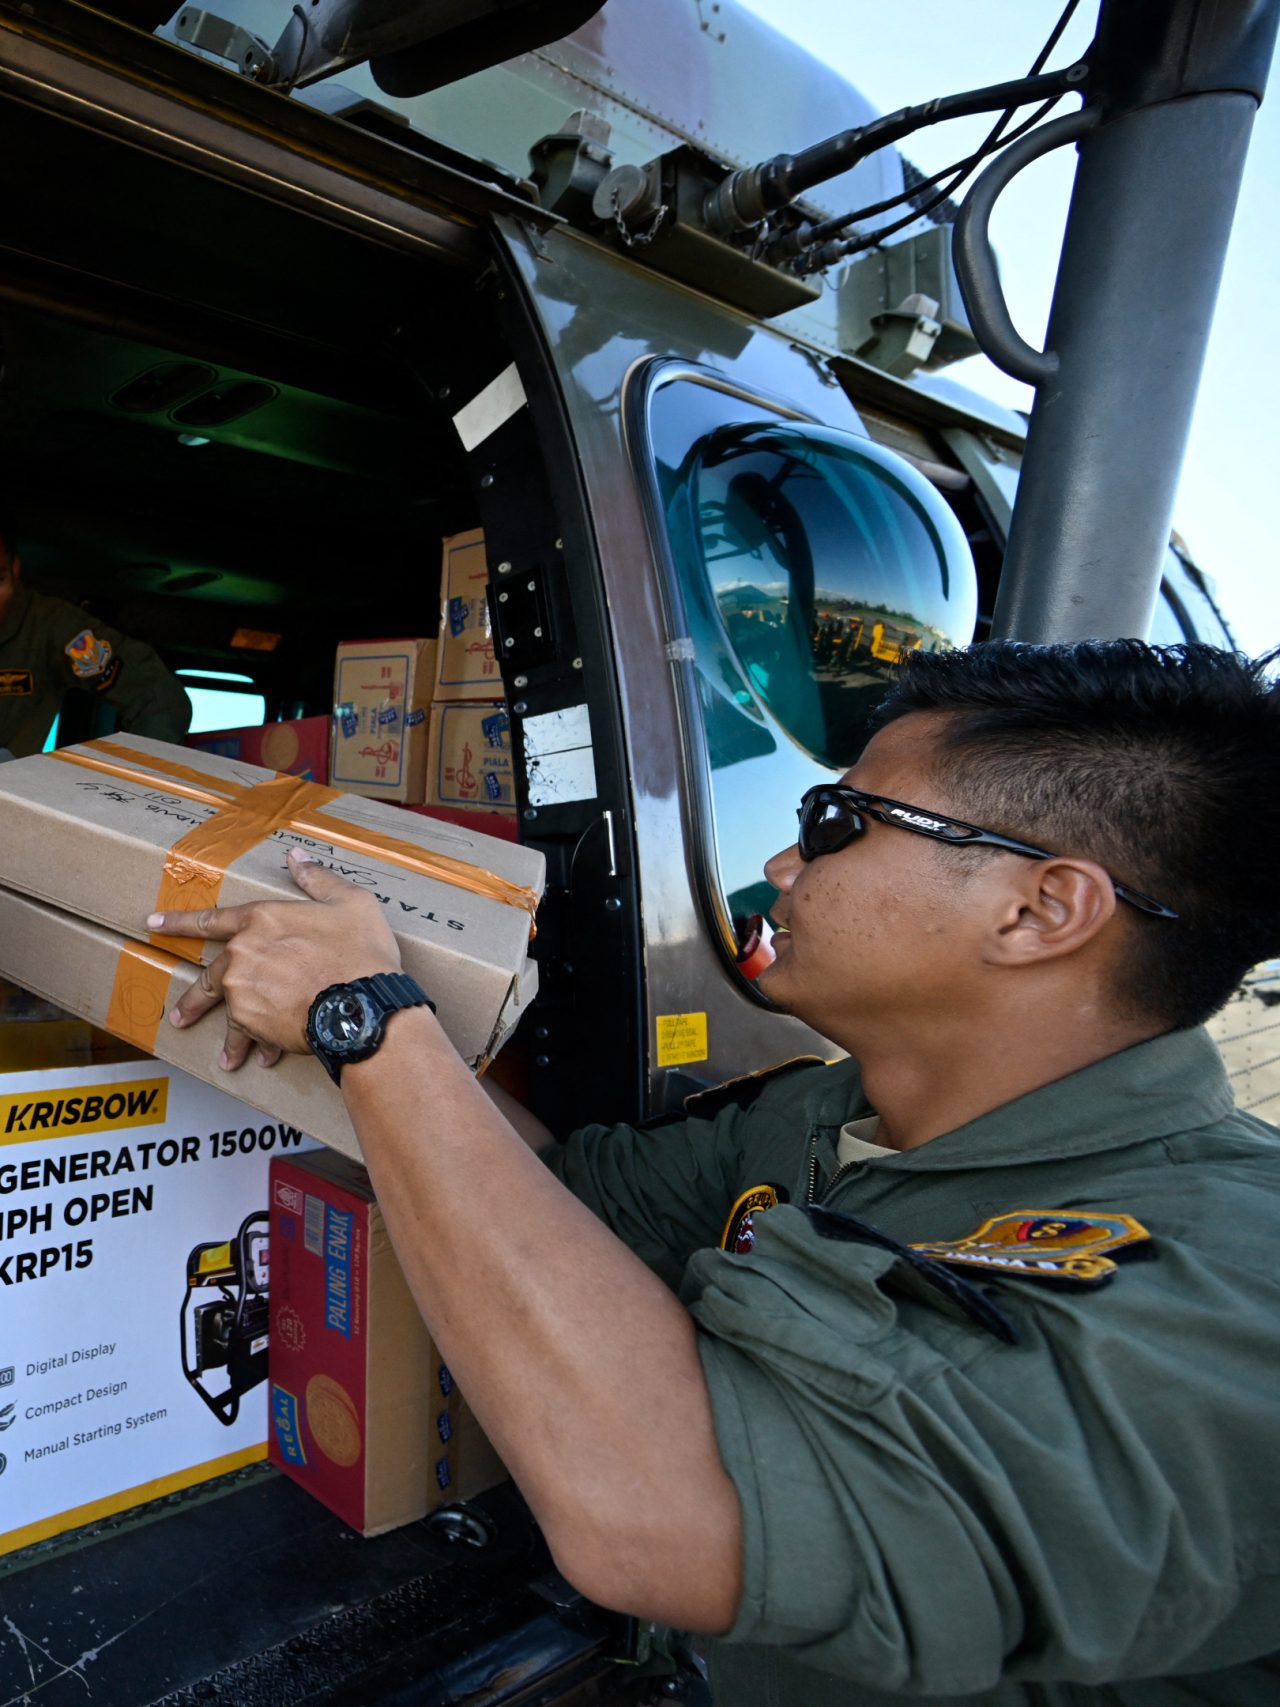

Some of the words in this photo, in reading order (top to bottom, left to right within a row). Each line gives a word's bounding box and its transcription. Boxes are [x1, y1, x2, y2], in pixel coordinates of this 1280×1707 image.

[483, 758, 510, 767] PIALA
[890, 808, 947, 828] RUDY
[4, 1088, 160, 1134] KRISBOW
[209, 1123, 304, 1159] 1500W
[63, 1184, 155, 1227] OPEN
[326, 1208, 351, 1261] ENAK
[326, 1266, 350, 1332] PALING
[25, 1353, 69, 1377] Digital
[71, 1342, 117, 1364] Display
[24, 1392, 83, 1421] Compact
[86, 1378, 129, 1402] Design
[24, 1438, 70, 1463] Manual
[73, 1421, 122, 1446] Starting
[125, 1407, 168, 1432] System
[276, 1396, 297, 1458] REGAL
